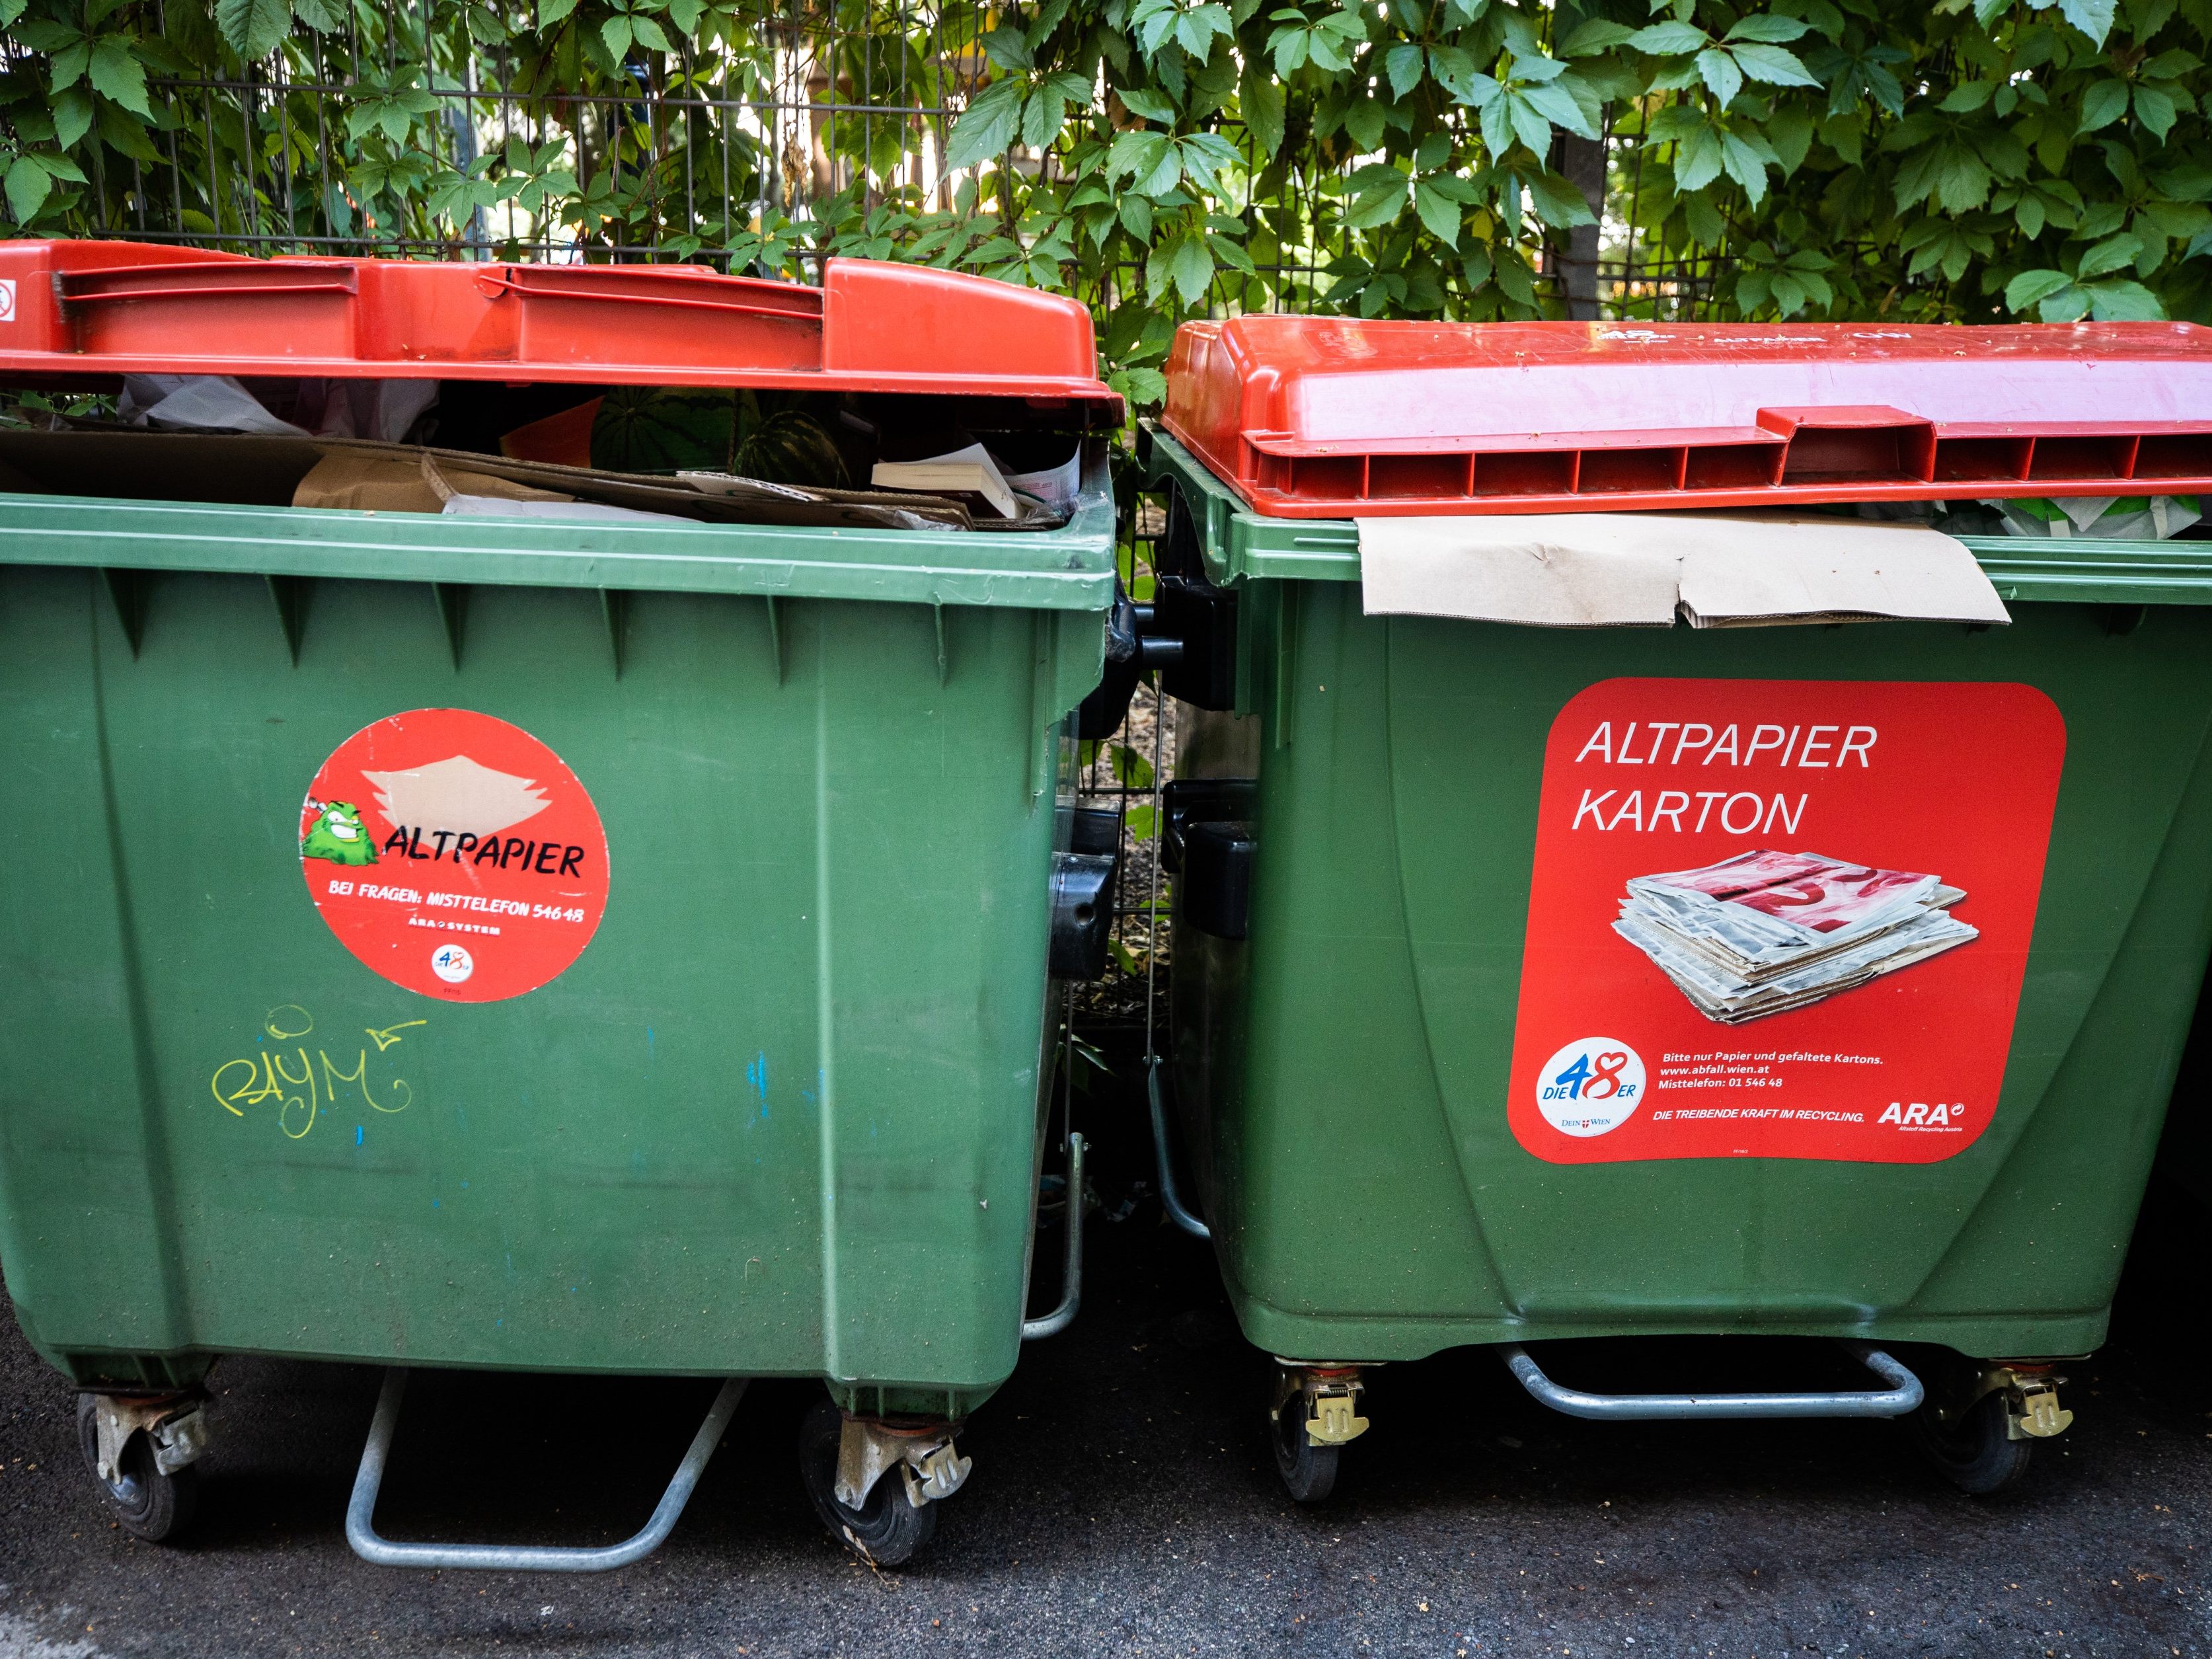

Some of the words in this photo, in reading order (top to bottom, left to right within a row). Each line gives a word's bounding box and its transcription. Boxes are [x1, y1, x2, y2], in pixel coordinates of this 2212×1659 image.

[1575, 722, 1878, 767] ALTPAPIER
[1572, 789, 1808, 835] KARTON
[383, 825, 584, 878] ALTPAPIER
[328, 880, 354, 896] BEI
[358, 882, 423, 904] FRAGEN:
[426, 891, 530, 917] MISTTELEFON
[447, 922, 500, 935] SYSTEM
[1663, 1053, 1691, 1062] Bitte
[1714, 1052, 1751, 1062] Papier
[1753, 1052, 1776, 1060] und
[1778, 1052, 1831, 1063] gefaltete
[1834, 1054, 1883, 1064] Kartons.
[1660, 1065, 1770, 1075] www.abfall.wien.at
[1658, 1077, 1726, 1089] Misttelefon:
[1728, 1077, 1742, 1087] 01
[1745, 1077, 1766, 1087] 546
[1769, 1078, 1783, 1087] 48
[1653, 1111, 1672, 1120] DIE
[1675, 1109, 1739, 1119] TREIBENDE
[1741, 1109, 1779, 1118] KRAFT
[1780, 1110, 1794, 1118] IM
[1796, 1110, 1864, 1122] RECYCLING.
[1878, 1102, 1949, 1125] ARA
